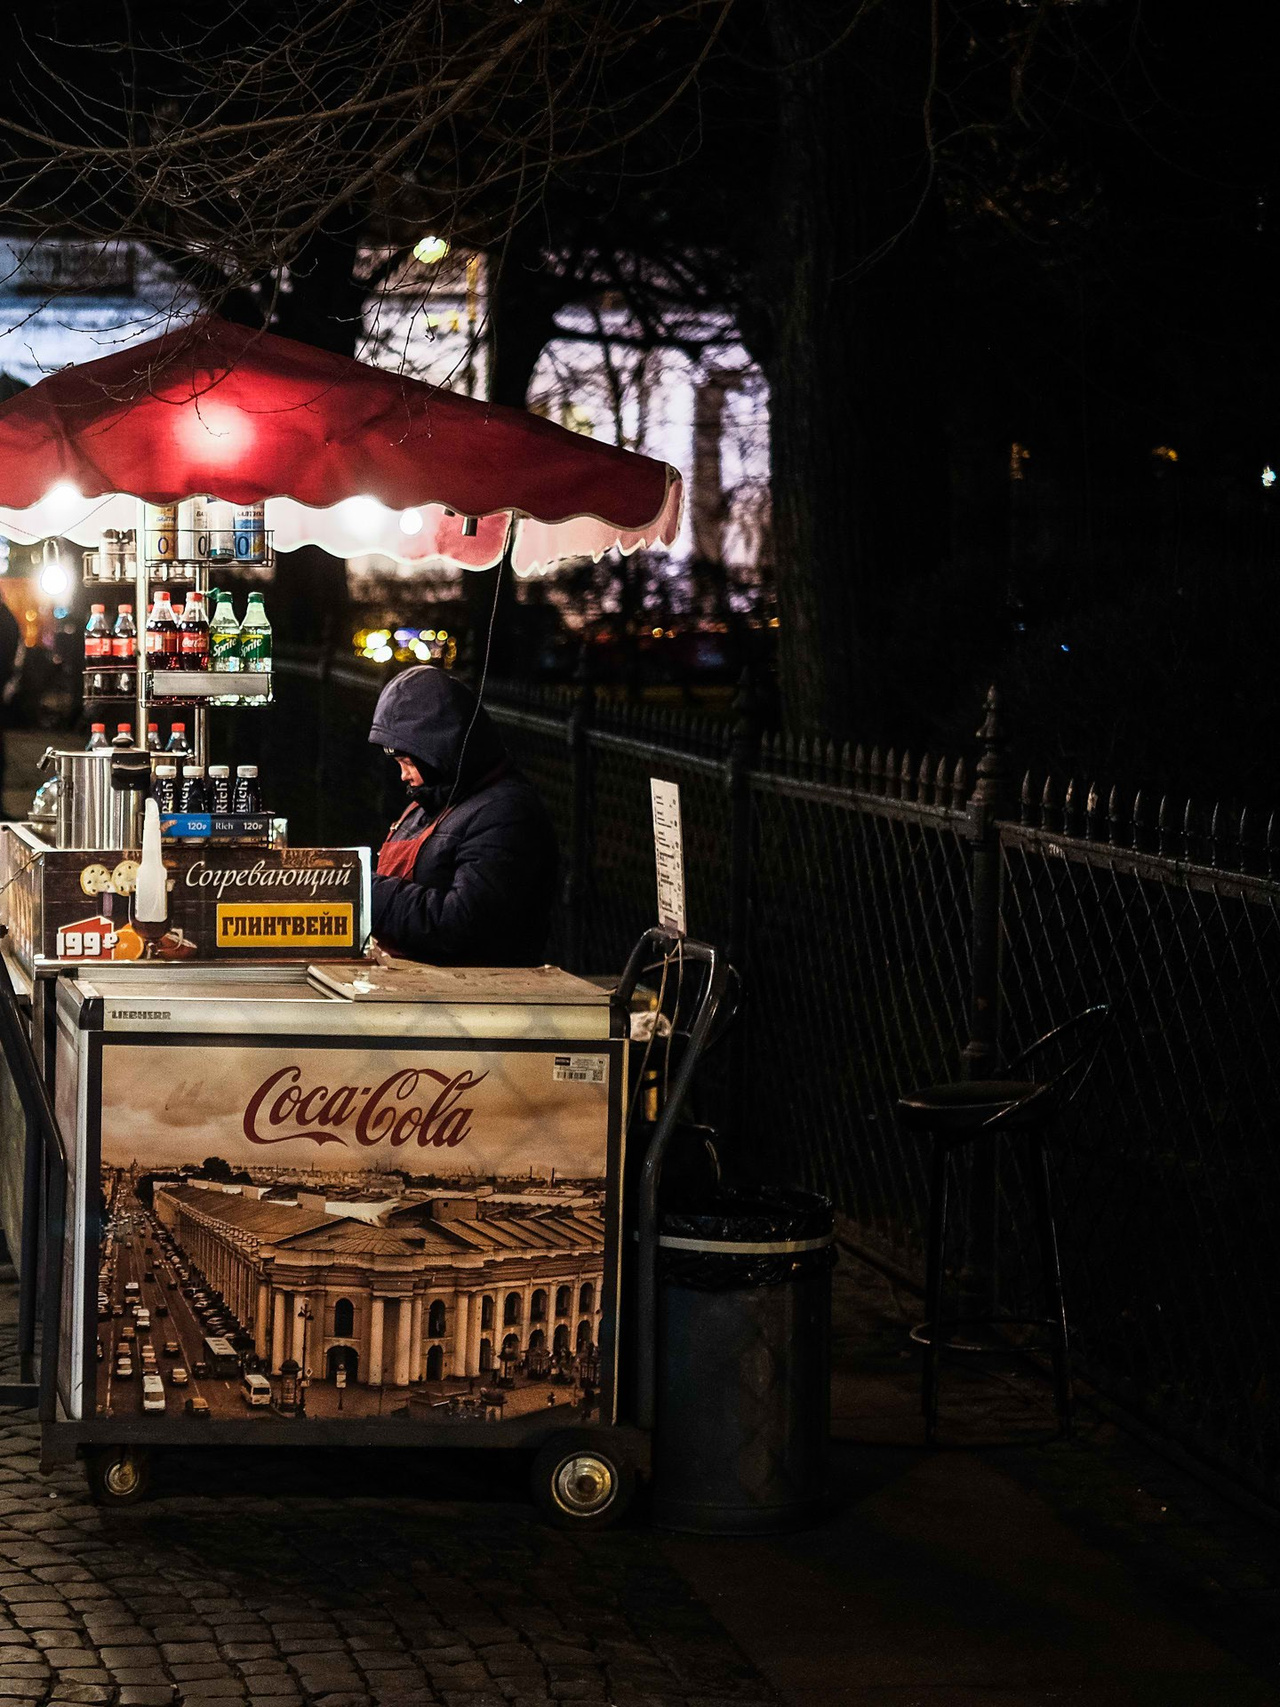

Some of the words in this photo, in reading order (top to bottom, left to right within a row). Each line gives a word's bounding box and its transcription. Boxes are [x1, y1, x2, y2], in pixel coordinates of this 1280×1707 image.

[213, 637, 237, 658] Sprite
[240, 637, 262, 658] Sprite
[162, 782, 174, 814] Rich
[216, 782, 228, 814] Rich
[236, 782, 248, 814] Rich
[215, 822, 234, 831] Rich
[185, 860, 352, 899] Согревающий
[221, 911, 349, 937] ГЛИНТВЕЙН
[111, 1010, 172, 1020] LIEBHERR
[243, 1066, 490, 1147] Coca-Cola
